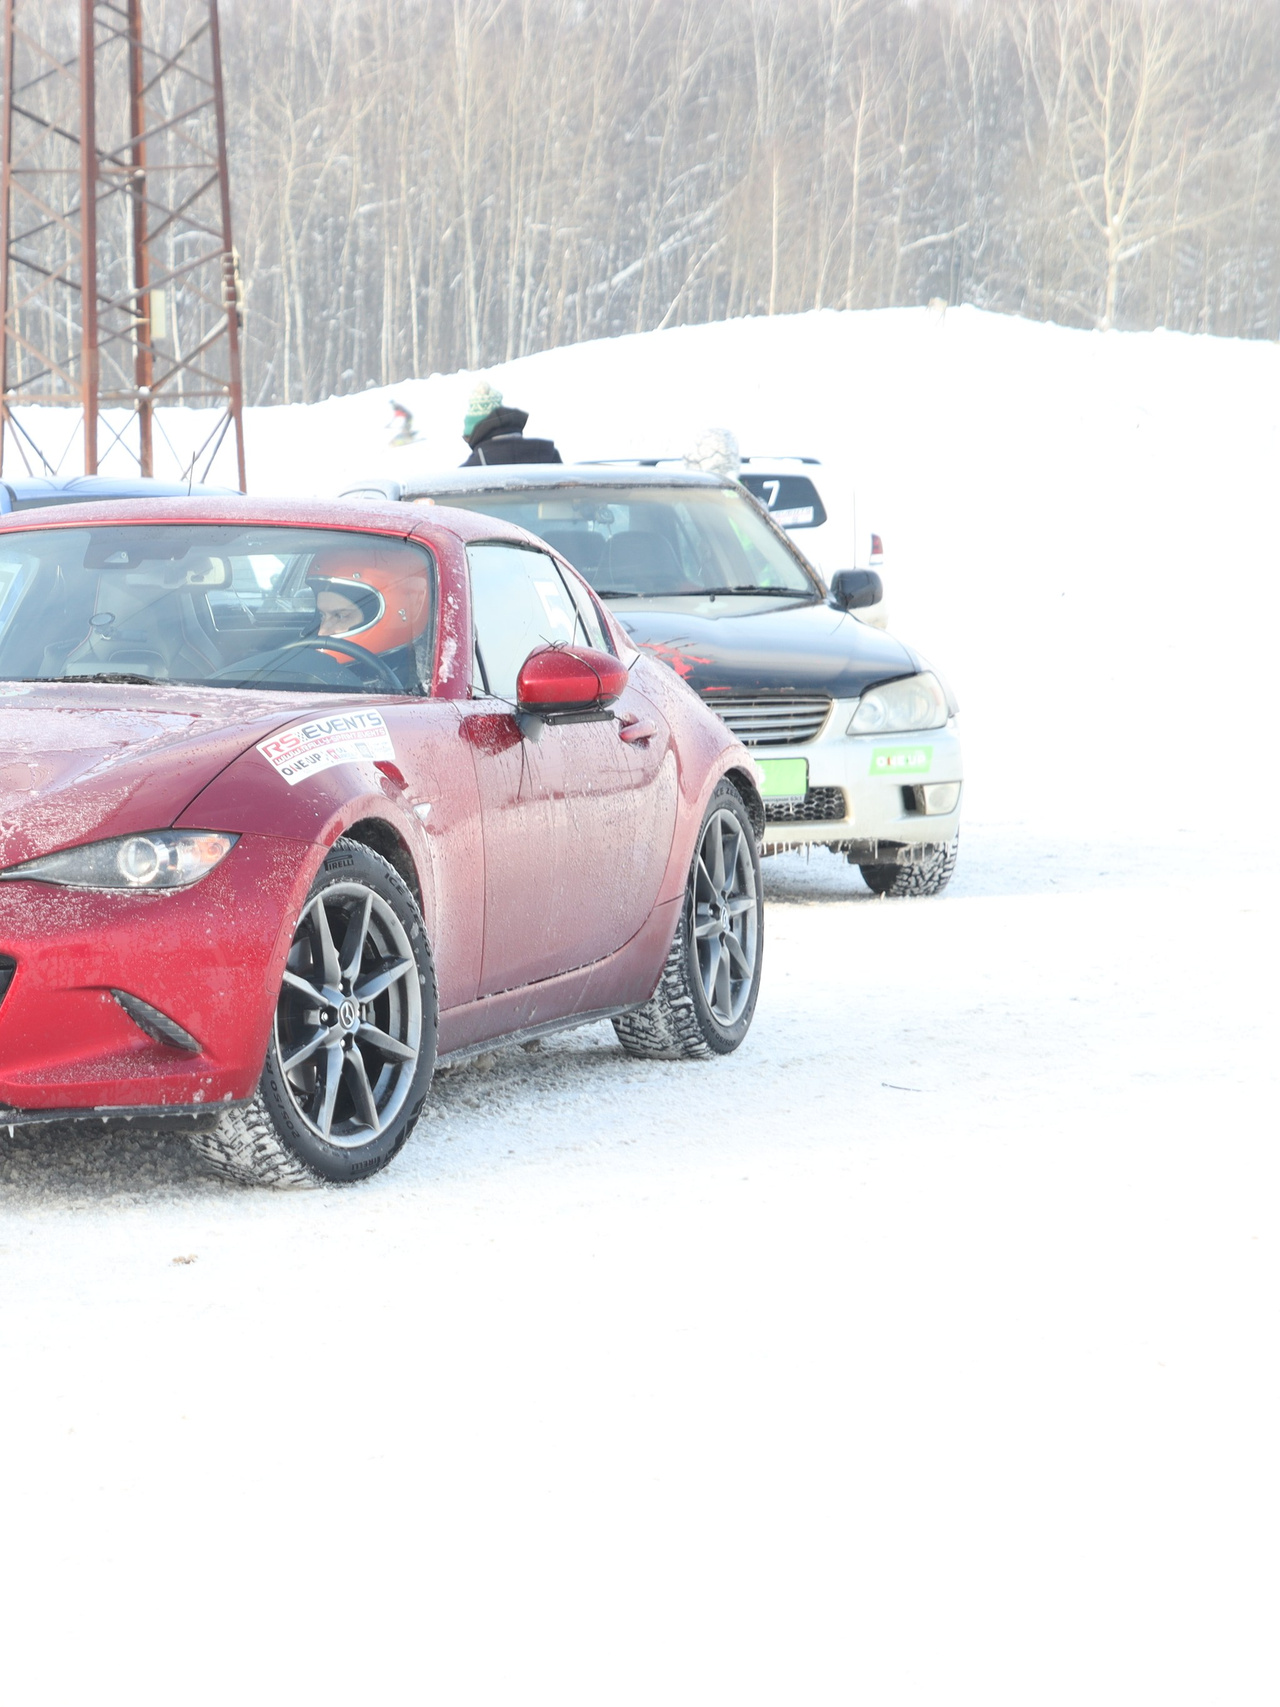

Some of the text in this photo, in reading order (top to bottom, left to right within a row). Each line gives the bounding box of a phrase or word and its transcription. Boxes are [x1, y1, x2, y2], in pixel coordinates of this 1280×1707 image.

[763, 480, 780, 506] 7
[533, 581, 579, 646] 5
[262, 733, 301, 758] RS
[302, 712, 382, 740] EVENTS
[282, 753, 322, 775] ONE UP
[877, 754, 925, 766] ONE UP
[324, 854, 354, 872] PIRELLI
[384, 872, 407, 895] ICE
